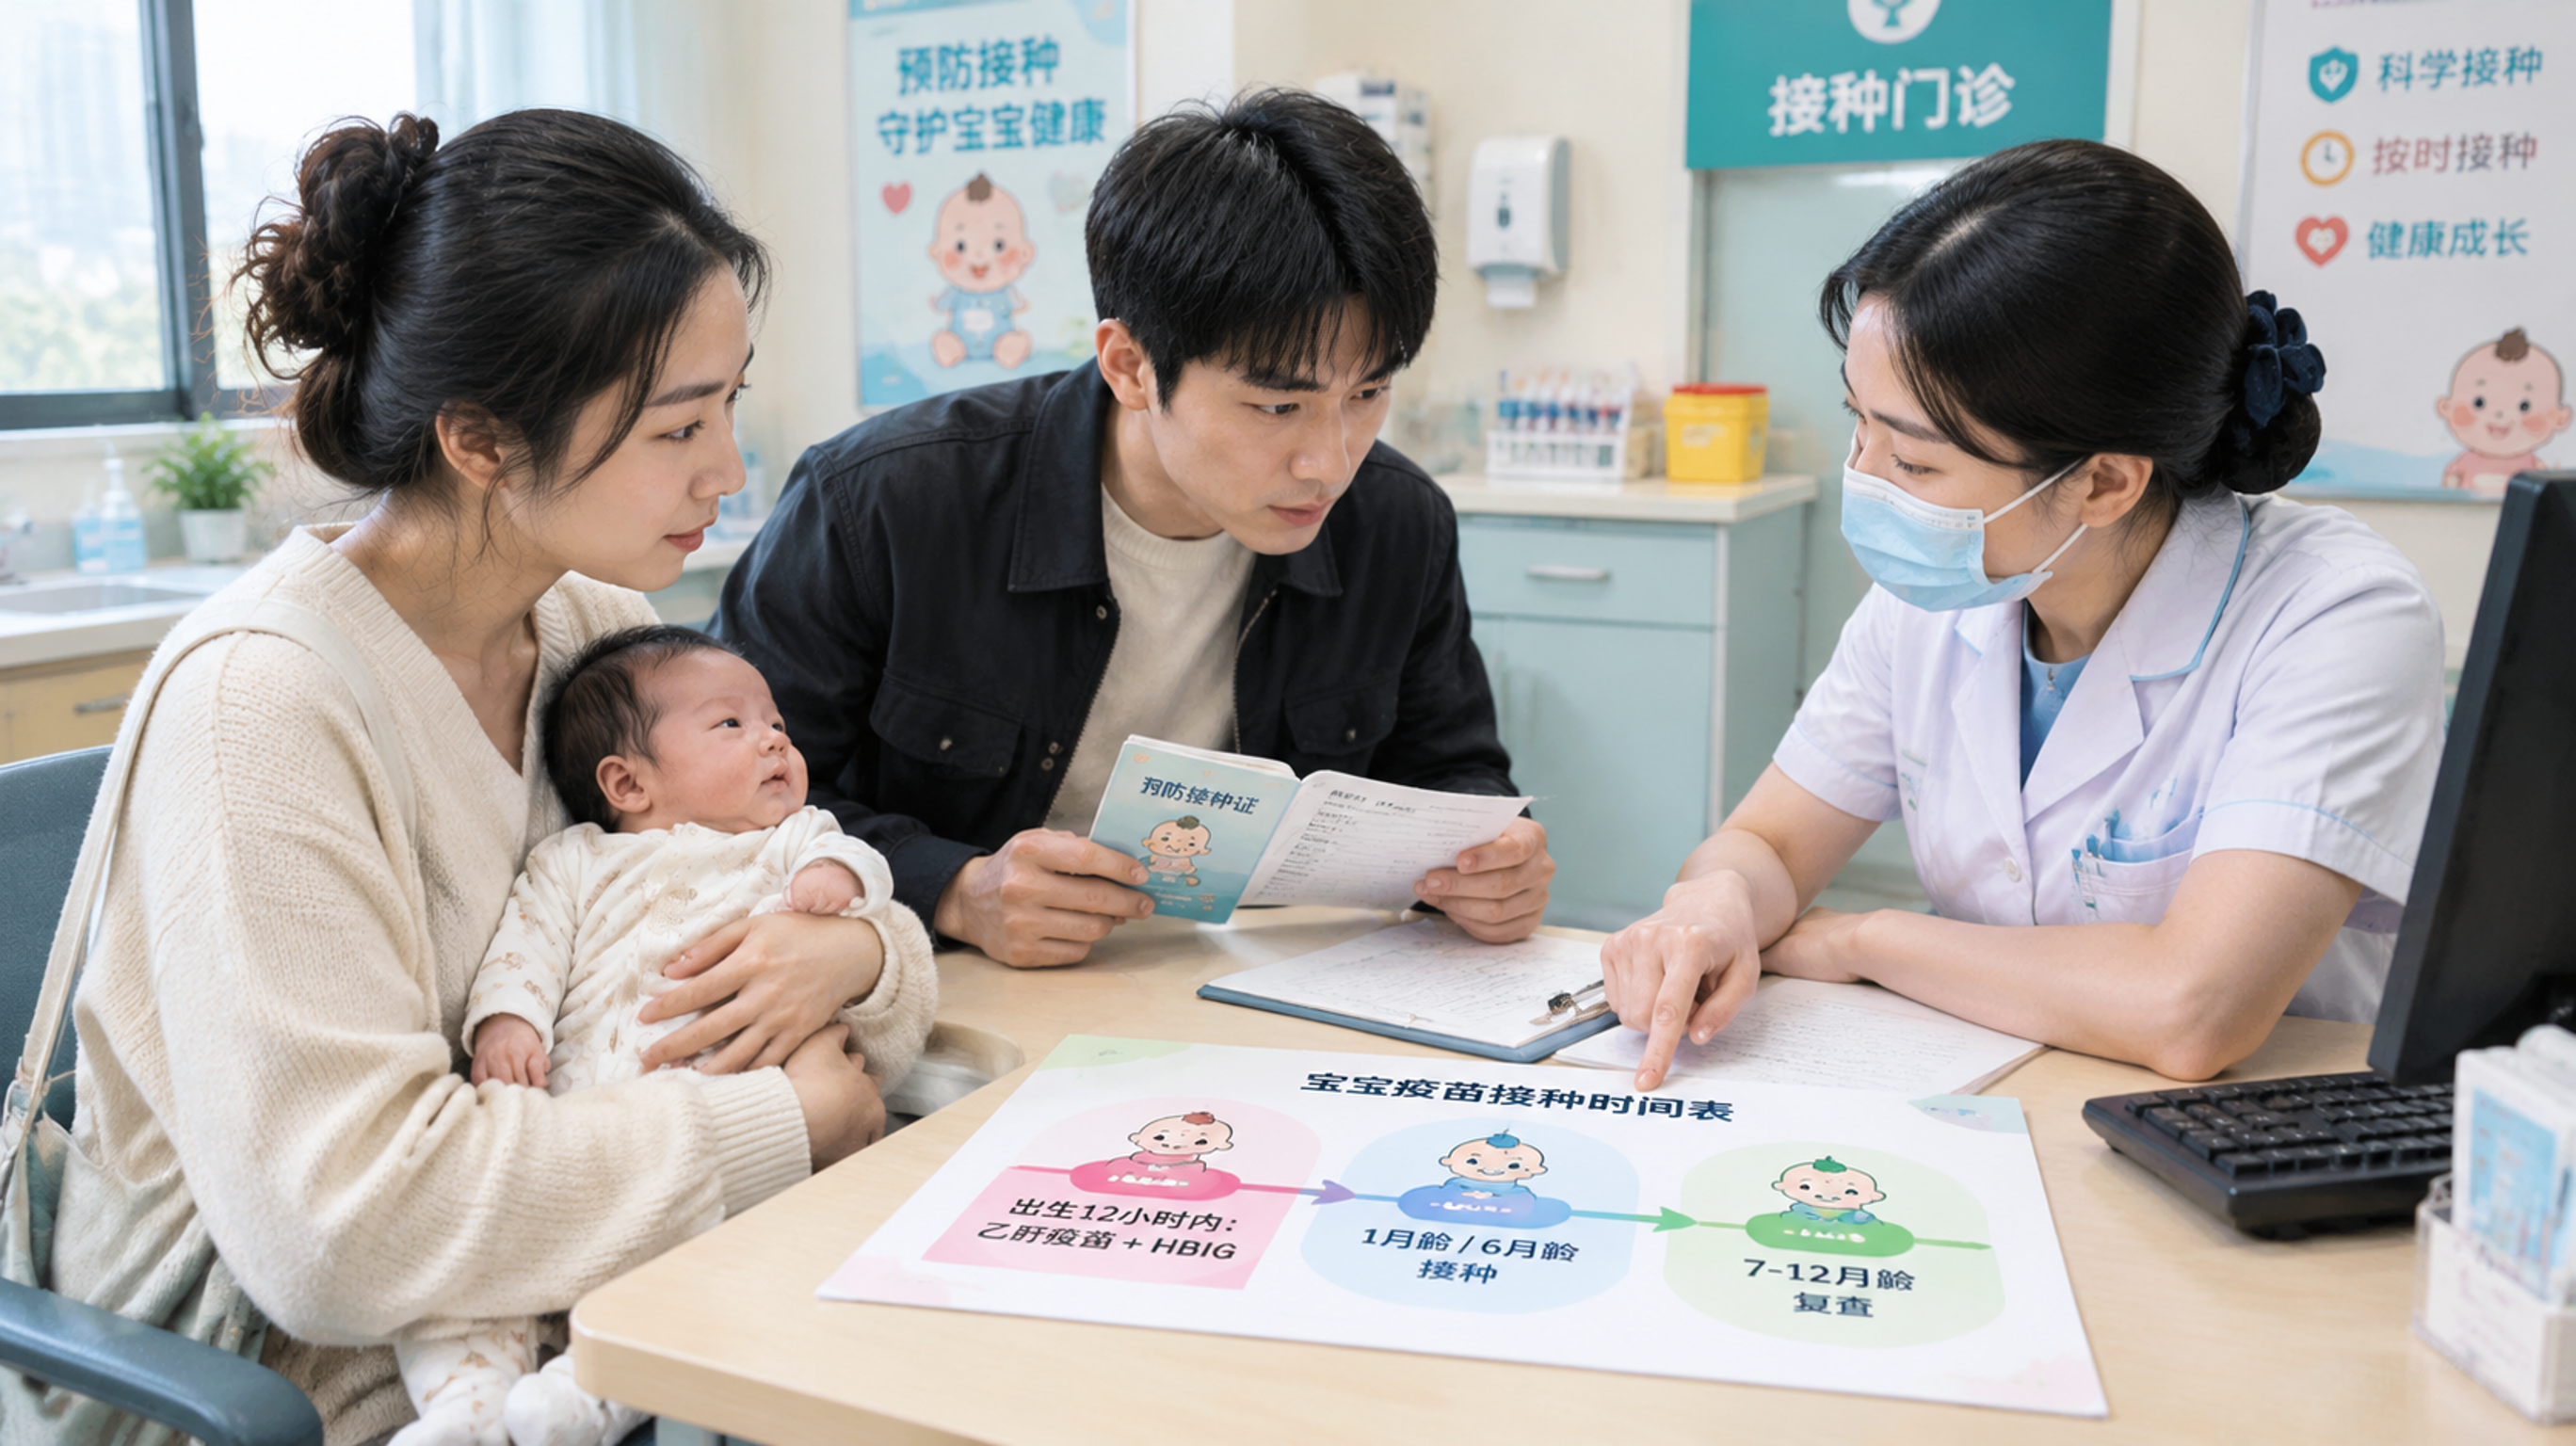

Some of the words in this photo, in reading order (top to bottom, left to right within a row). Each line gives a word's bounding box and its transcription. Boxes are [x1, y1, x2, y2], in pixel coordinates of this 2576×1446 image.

[897, 35, 1059, 95] 预防接种
[2377, 45, 2543, 91] 科学接种
[1767, 62, 2016, 137] 接种门诊
[877, 97, 1105, 155] 守护宝宝健康
[2373, 132, 2538, 175] 按时接种
[2367, 217, 2530, 259] 健康成长
[1300, 1072, 1734, 1122] 宝宝疫苗接种时间表
[1151, 1238, 1237, 1260] HBIG
